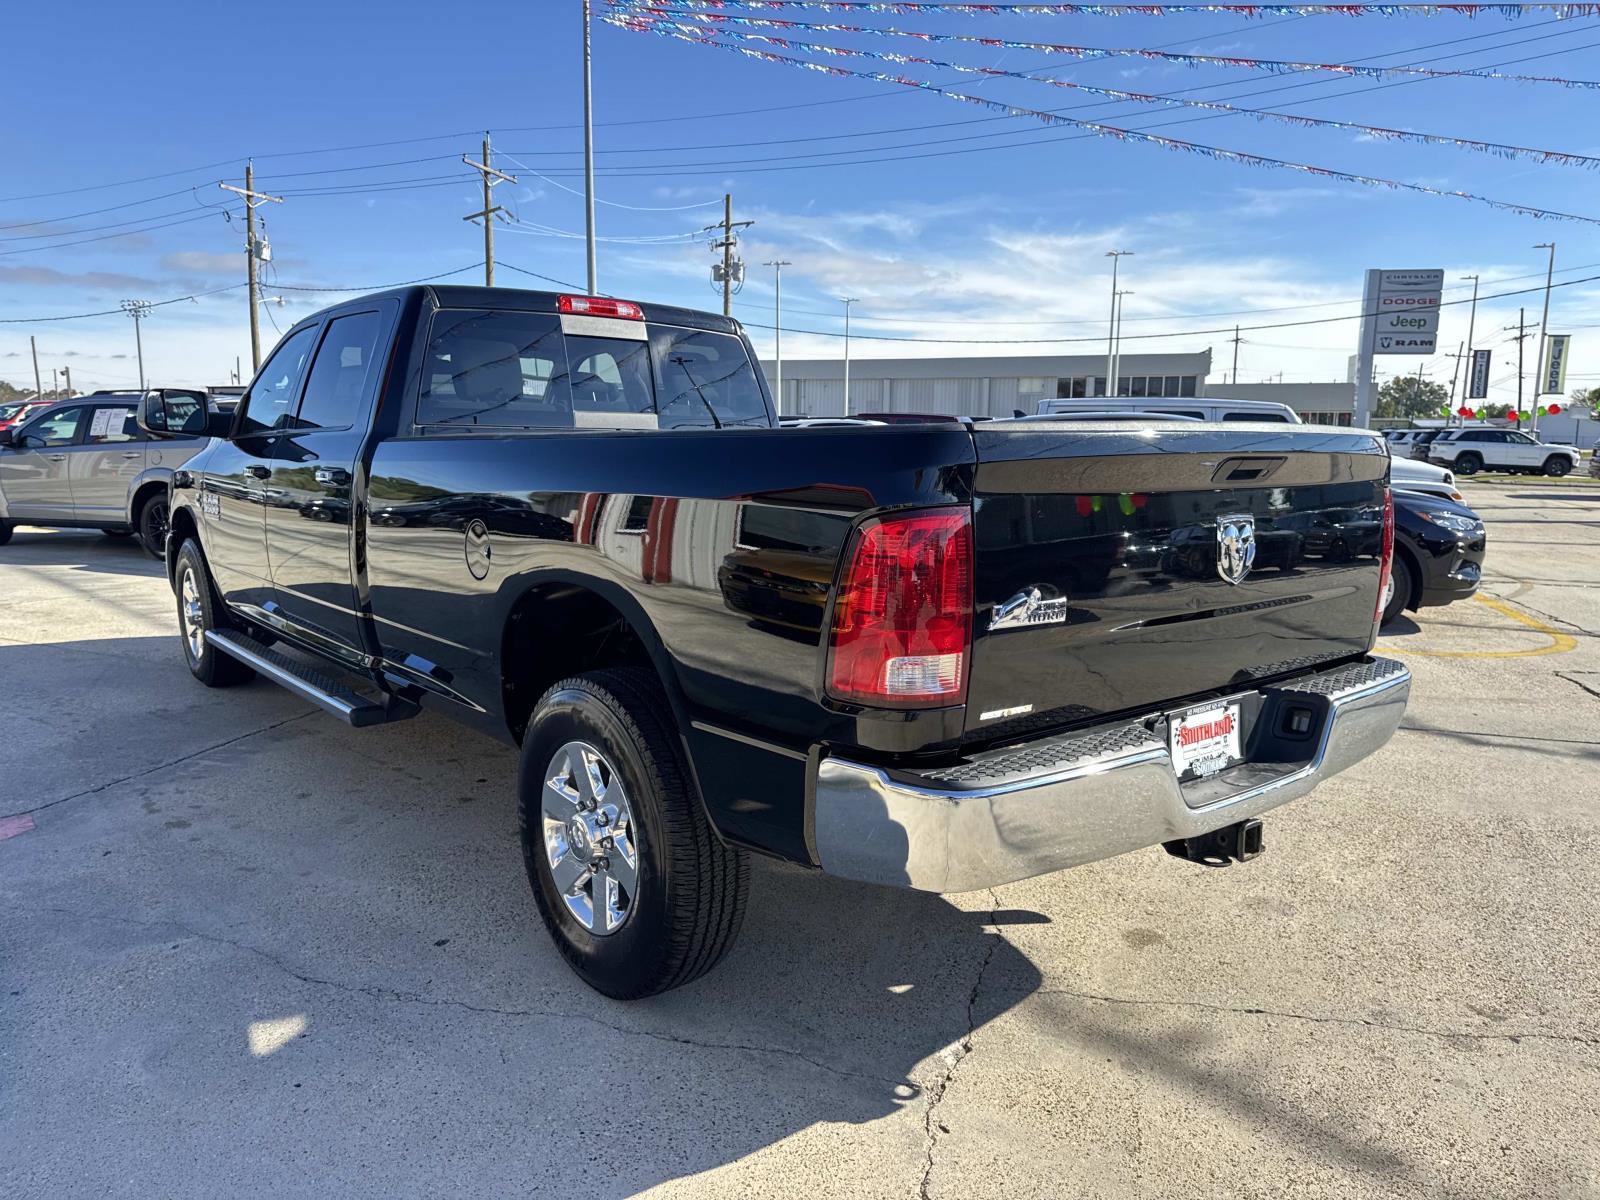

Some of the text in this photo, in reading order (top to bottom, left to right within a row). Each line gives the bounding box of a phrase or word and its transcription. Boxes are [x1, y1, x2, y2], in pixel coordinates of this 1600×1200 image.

[1382, 298, 1438, 306] DODGE
[1390, 315, 1427, 330] Jeep
[1475, 363, 1484, 396] TRUCKS
[1549, 348, 1563, 391] Jeep
[1180, 714, 1232, 747] SOUTHLAND
